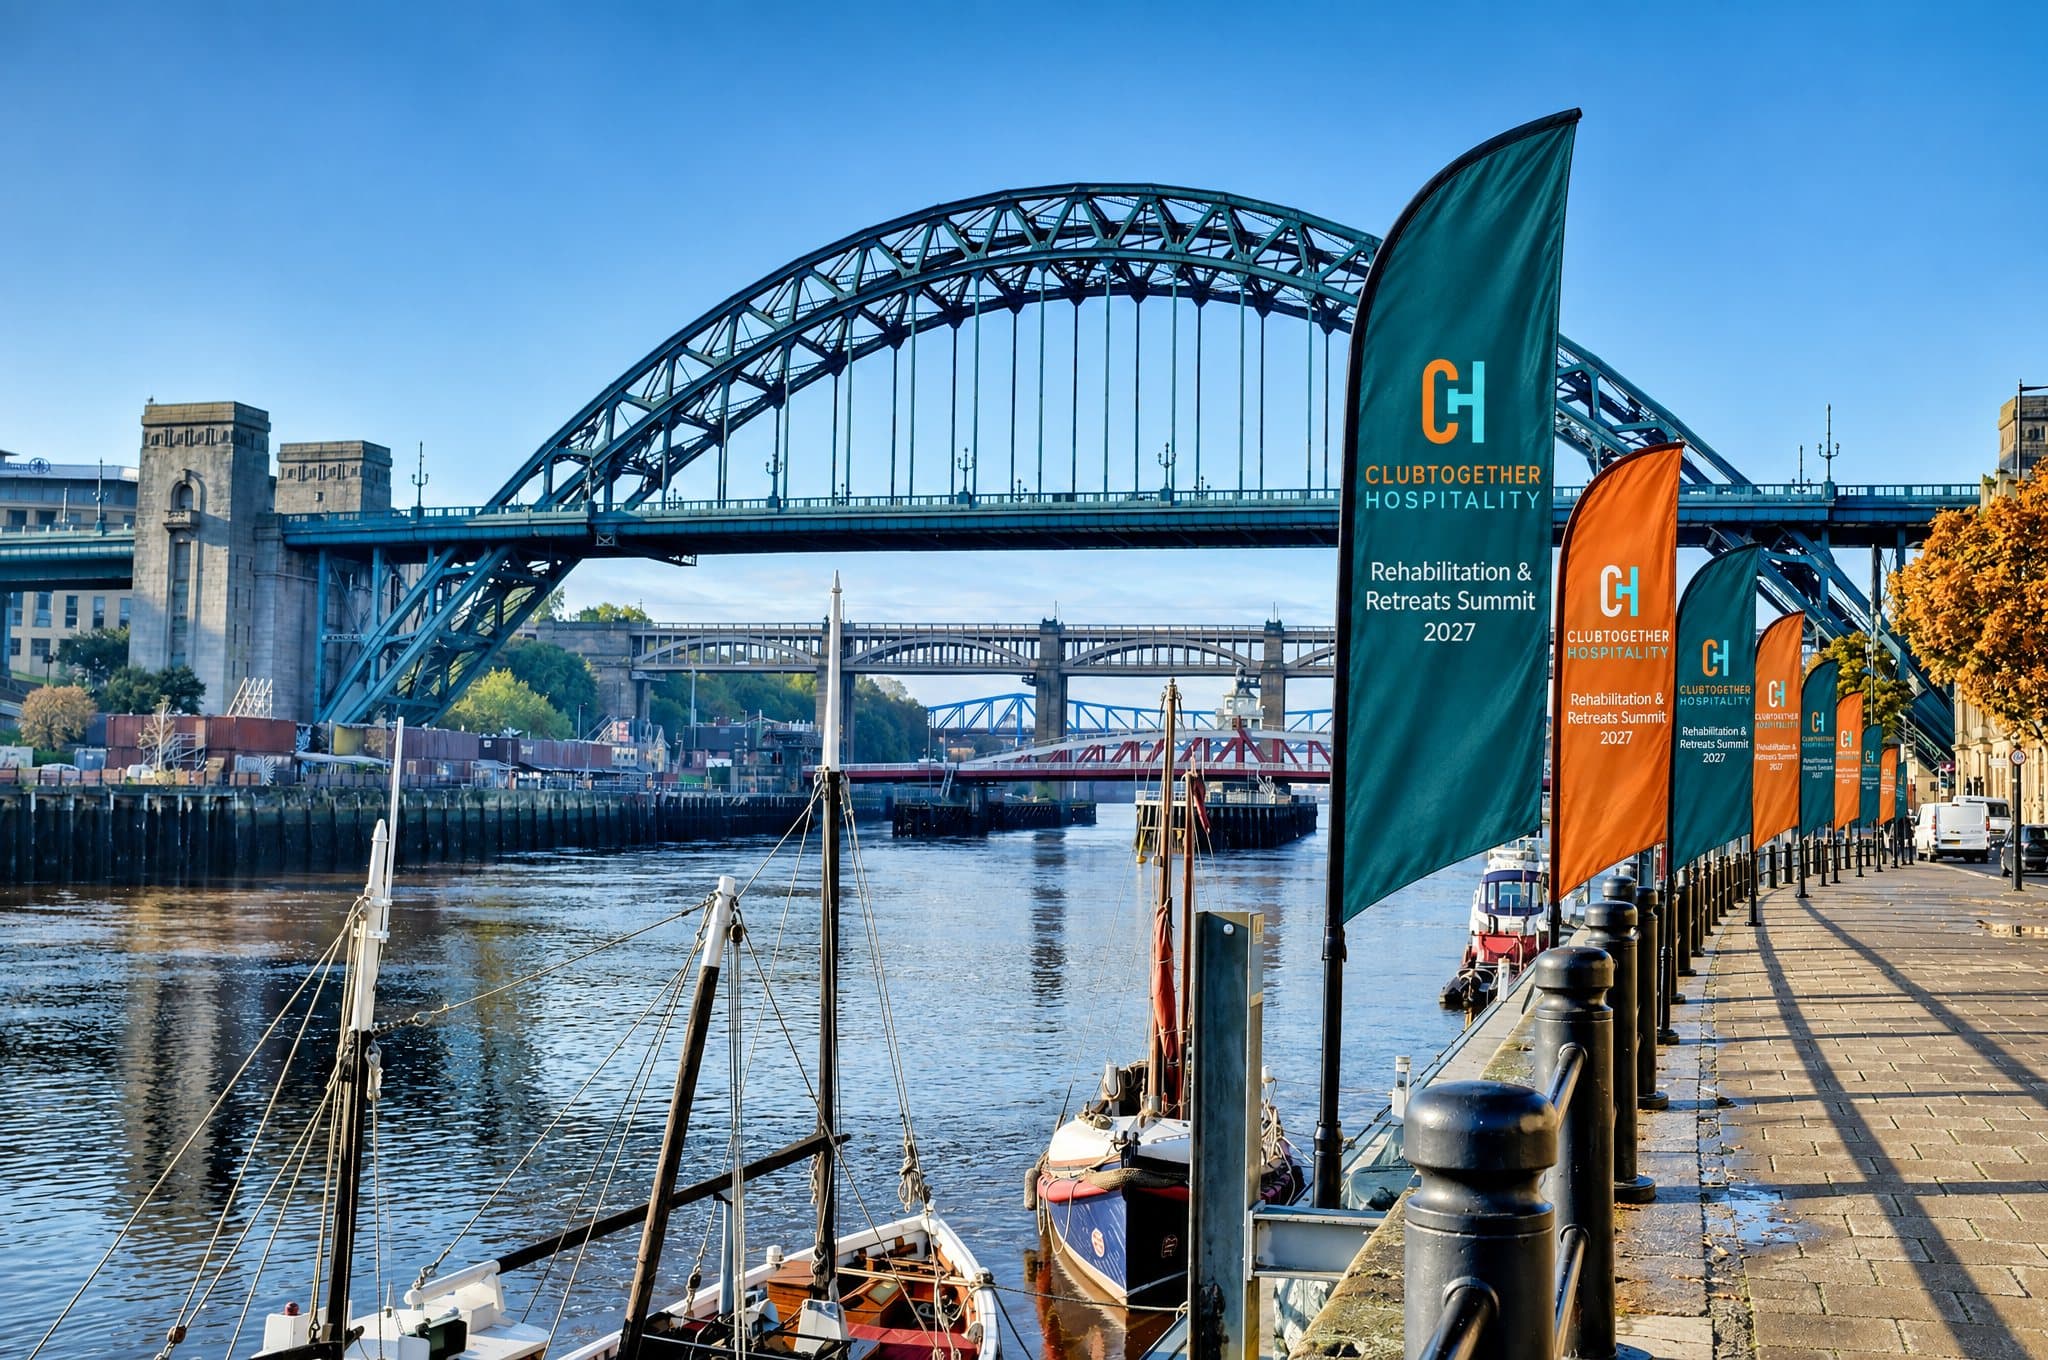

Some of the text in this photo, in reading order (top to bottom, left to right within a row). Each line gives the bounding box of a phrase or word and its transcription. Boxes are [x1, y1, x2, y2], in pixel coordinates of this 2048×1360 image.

[1422, 359, 1485, 444] CH
[1365, 465, 1541, 484] CLUBTOGETHER
[1365, 491, 1540, 509] HOSPITALITY
[1371, 561, 1532, 582] Rehabilitation &
[1601, 564, 1638, 617] CH
[1366, 590, 1536, 611] Retreats Summit
[1424, 622, 1476, 642] 2027
[1567, 630, 1669, 643] CLUBTOGETHER
[1567, 646, 1669, 660] HOSPITALITY
[1702, 639, 1729, 677] CH
[1680, 685, 1751, 695] CLUBTOGETHER
[1571, 692, 1664, 706] Rehabilitation &
[1680, 696, 1750, 706] HOSPITALITY
[1568, 711, 1666, 725] Retreats Summit
[1600, 730, 1633, 745] 2027
[1682, 727, 1747, 737] Rehabilitation &
[1680, 739, 1749, 749] Retreats Summit
[1702, 752, 1726, 763] 2027
